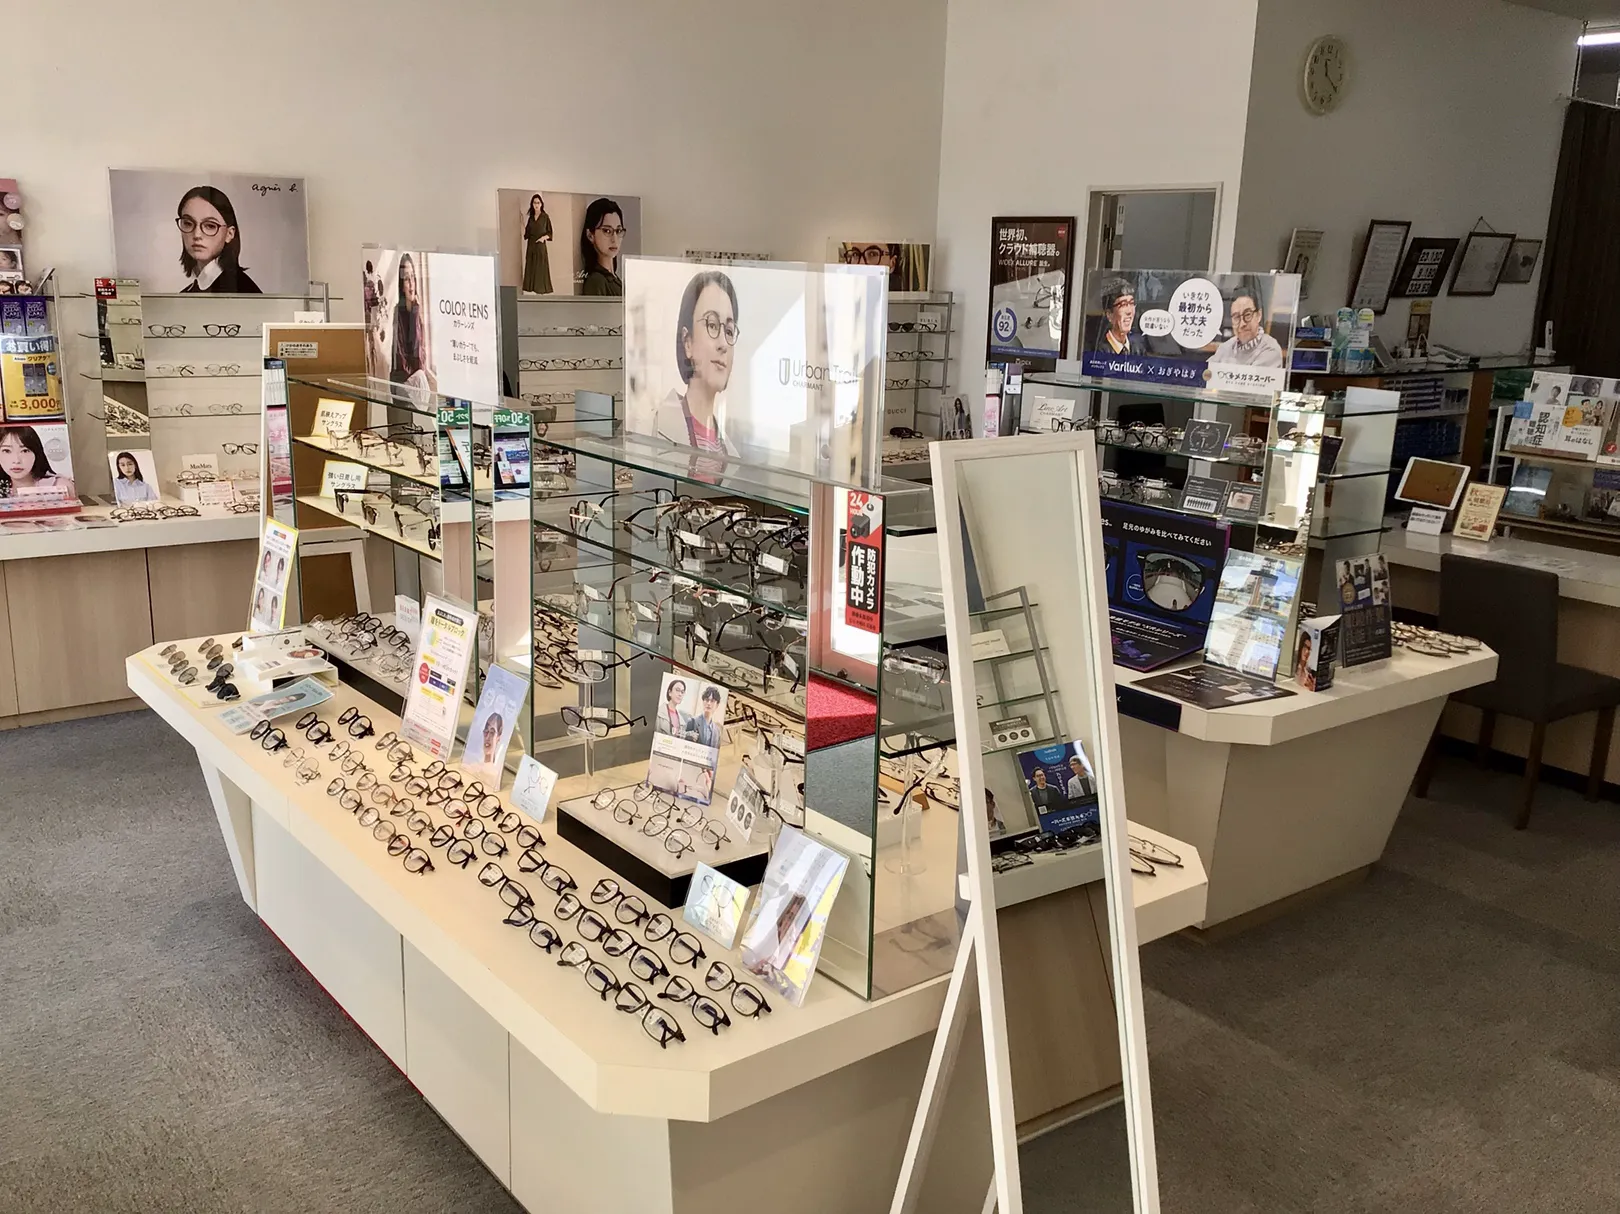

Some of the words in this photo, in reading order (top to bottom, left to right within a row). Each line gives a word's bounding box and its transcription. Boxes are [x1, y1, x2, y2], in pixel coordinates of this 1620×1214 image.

[999, 228, 1028, 241] 世界初、
[999, 242, 1060, 256] クラウド補聴器。
[1182, 291, 1210, 301] いきなり
[439, 299, 466, 317] COLOR
[468, 302, 489, 320] LENS
[1178, 301, 1212, 314] 最初から
[453, 319, 475, 330] カラーレンズ
[1180, 314, 1207, 327] 大丈夫
[1182, 328, 1203, 338] だった
[793, 359, 830, 381] Urban
[1109, 360, 1143, 374] Varilux
[1158, 366, 1197, 379] おぎやはぎ
[1234, 373, 1276, 383] メガネスーパー
[792, 380, 824, 391] CHARMANT
[320, 410, 347, 419] 肌映えアップ
[321, 419, 343, 428] サングラス
[1532, 411, 1551, 446] 認知症
[1564, 435, 1593, 446] 耳のはなし
[327, 471, 361, 482] 強い日差し用
[330, 481, 356, 489] サングラス
[849, 492, 864, 508] 24
[849, 506, 864, 517] HOUR
[1122, 522, 1212, 547] 足元のゆがみを比べてみてください
[850, 544, 866, 607] 作動中
[866, 547, 877, 610] 防犯カメラ
